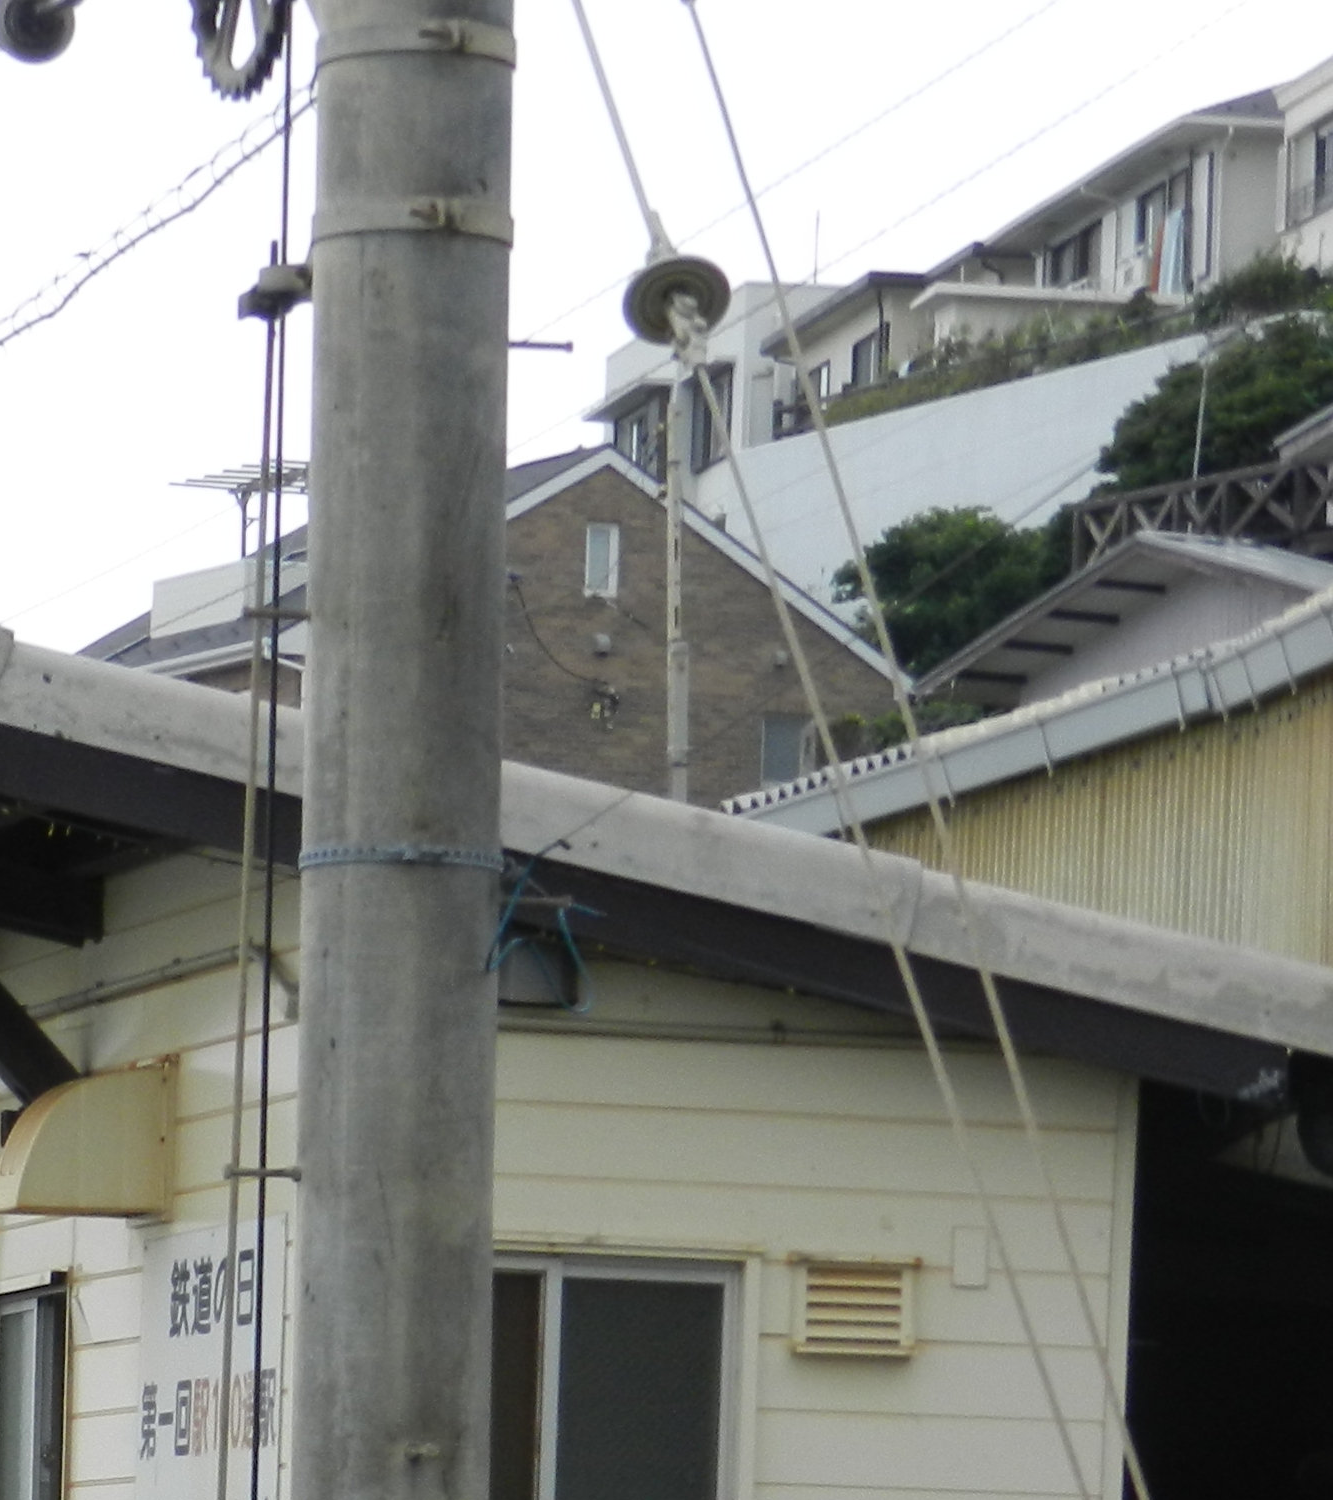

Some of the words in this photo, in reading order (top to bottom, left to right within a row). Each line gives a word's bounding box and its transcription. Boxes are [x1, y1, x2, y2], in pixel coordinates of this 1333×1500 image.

[169, 1249, 254, 1338] 鉄道の日
[140, 1368, 276, 1461] 第一回駅10選駅
